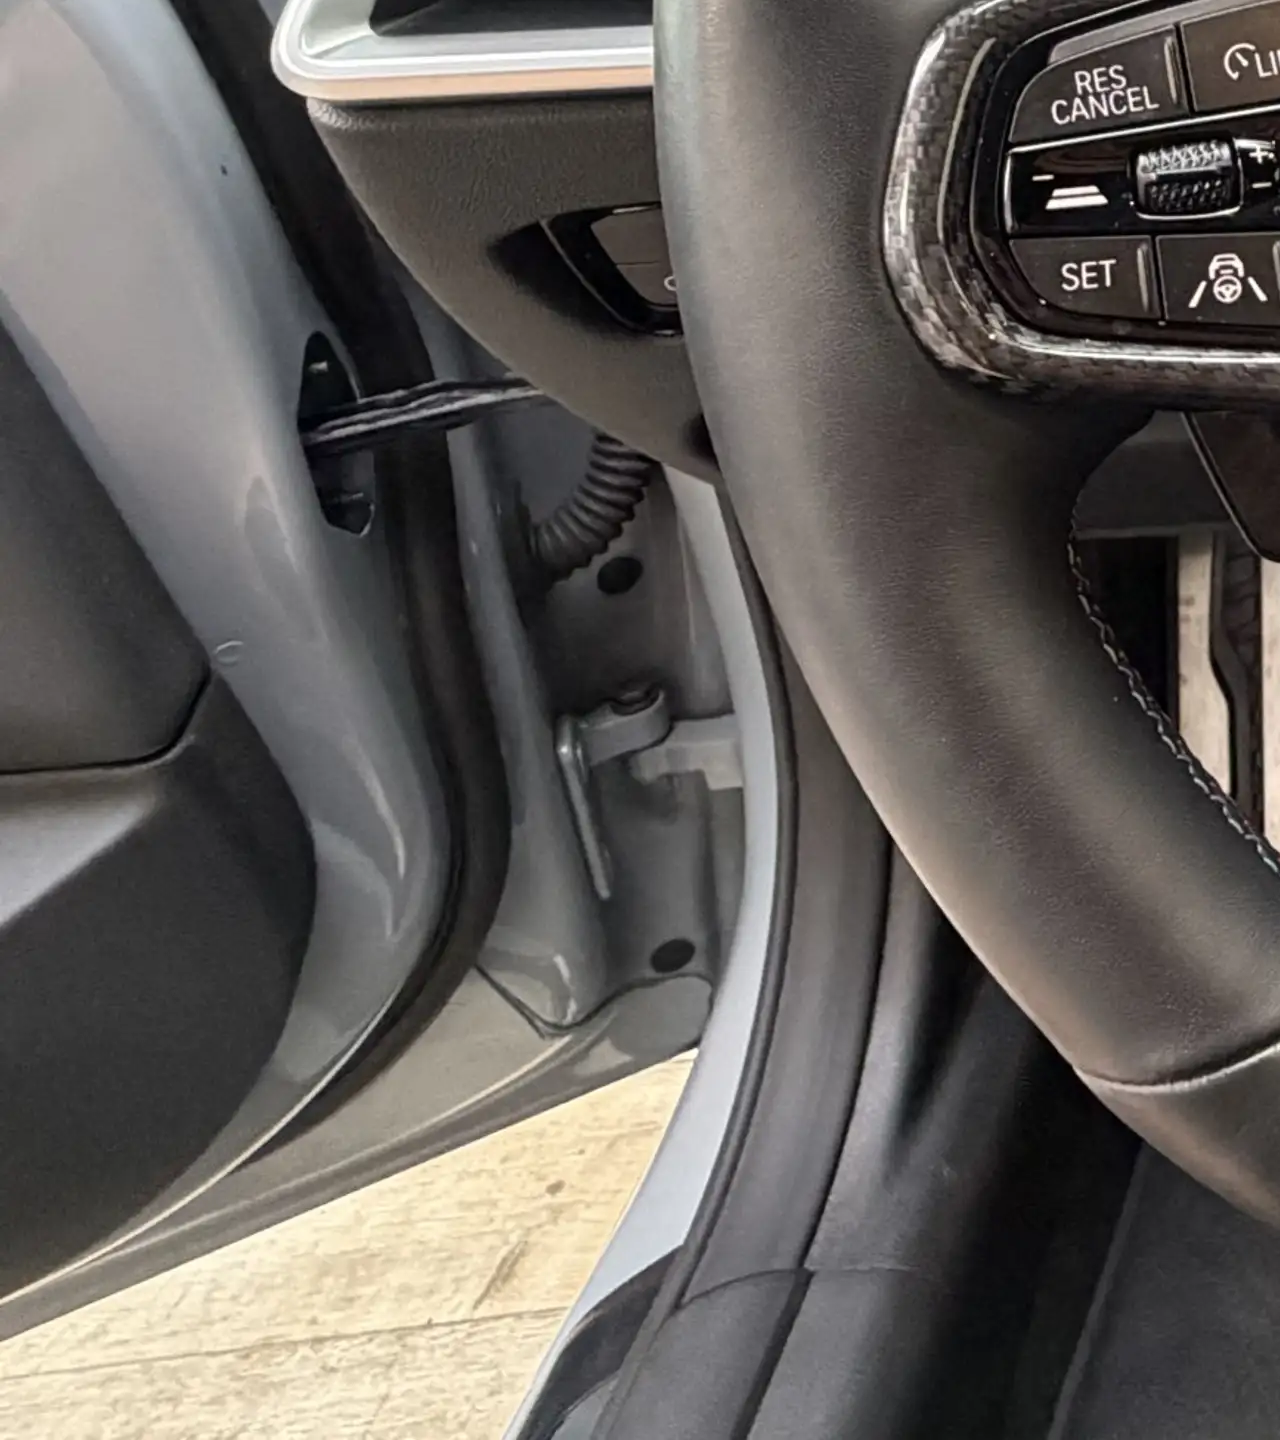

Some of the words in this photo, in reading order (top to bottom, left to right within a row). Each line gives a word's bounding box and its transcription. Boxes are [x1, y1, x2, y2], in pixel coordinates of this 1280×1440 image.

[1073, 63, 1127, 95] RES
[1050, 86, 1160, 126] CANCEL
[1060, 258, 1117, 292] SET
